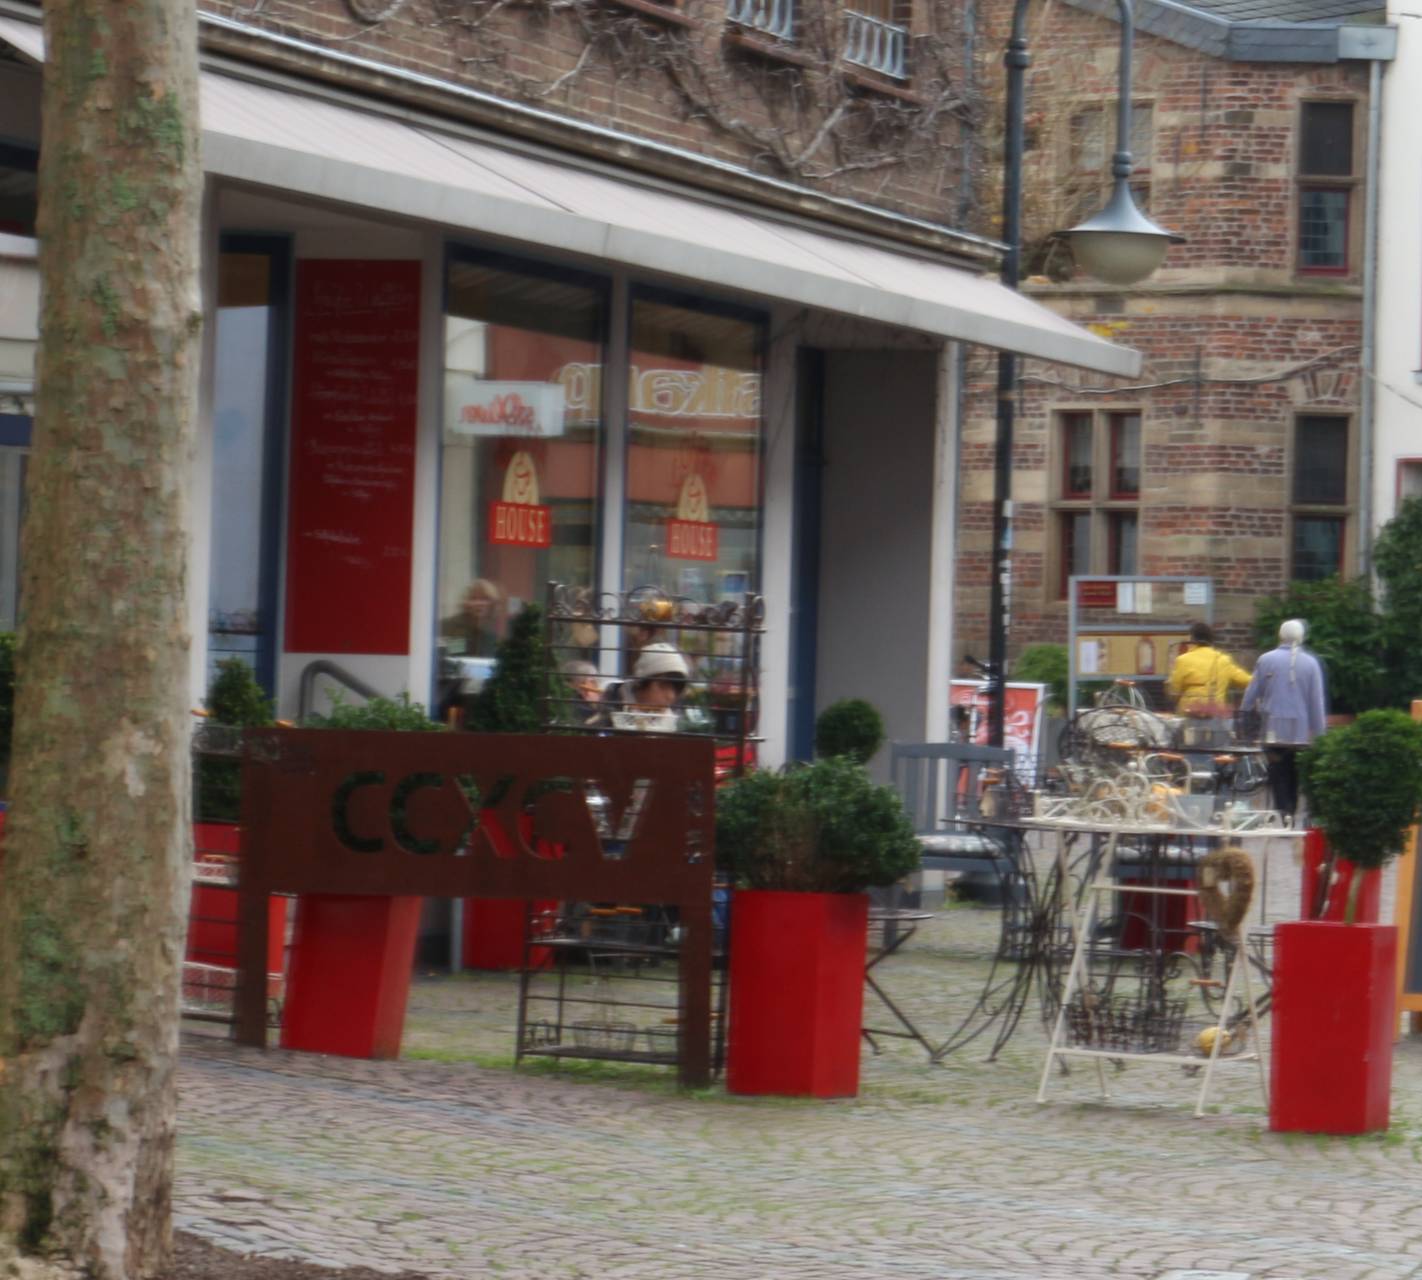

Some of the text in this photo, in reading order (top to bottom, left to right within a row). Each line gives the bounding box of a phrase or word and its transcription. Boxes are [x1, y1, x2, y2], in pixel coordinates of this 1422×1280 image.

[495, 505, 545, 543] HOUSE
[670, 522, 714, 557] HOUSE
[332, 771, 654, 861] CCXCV
